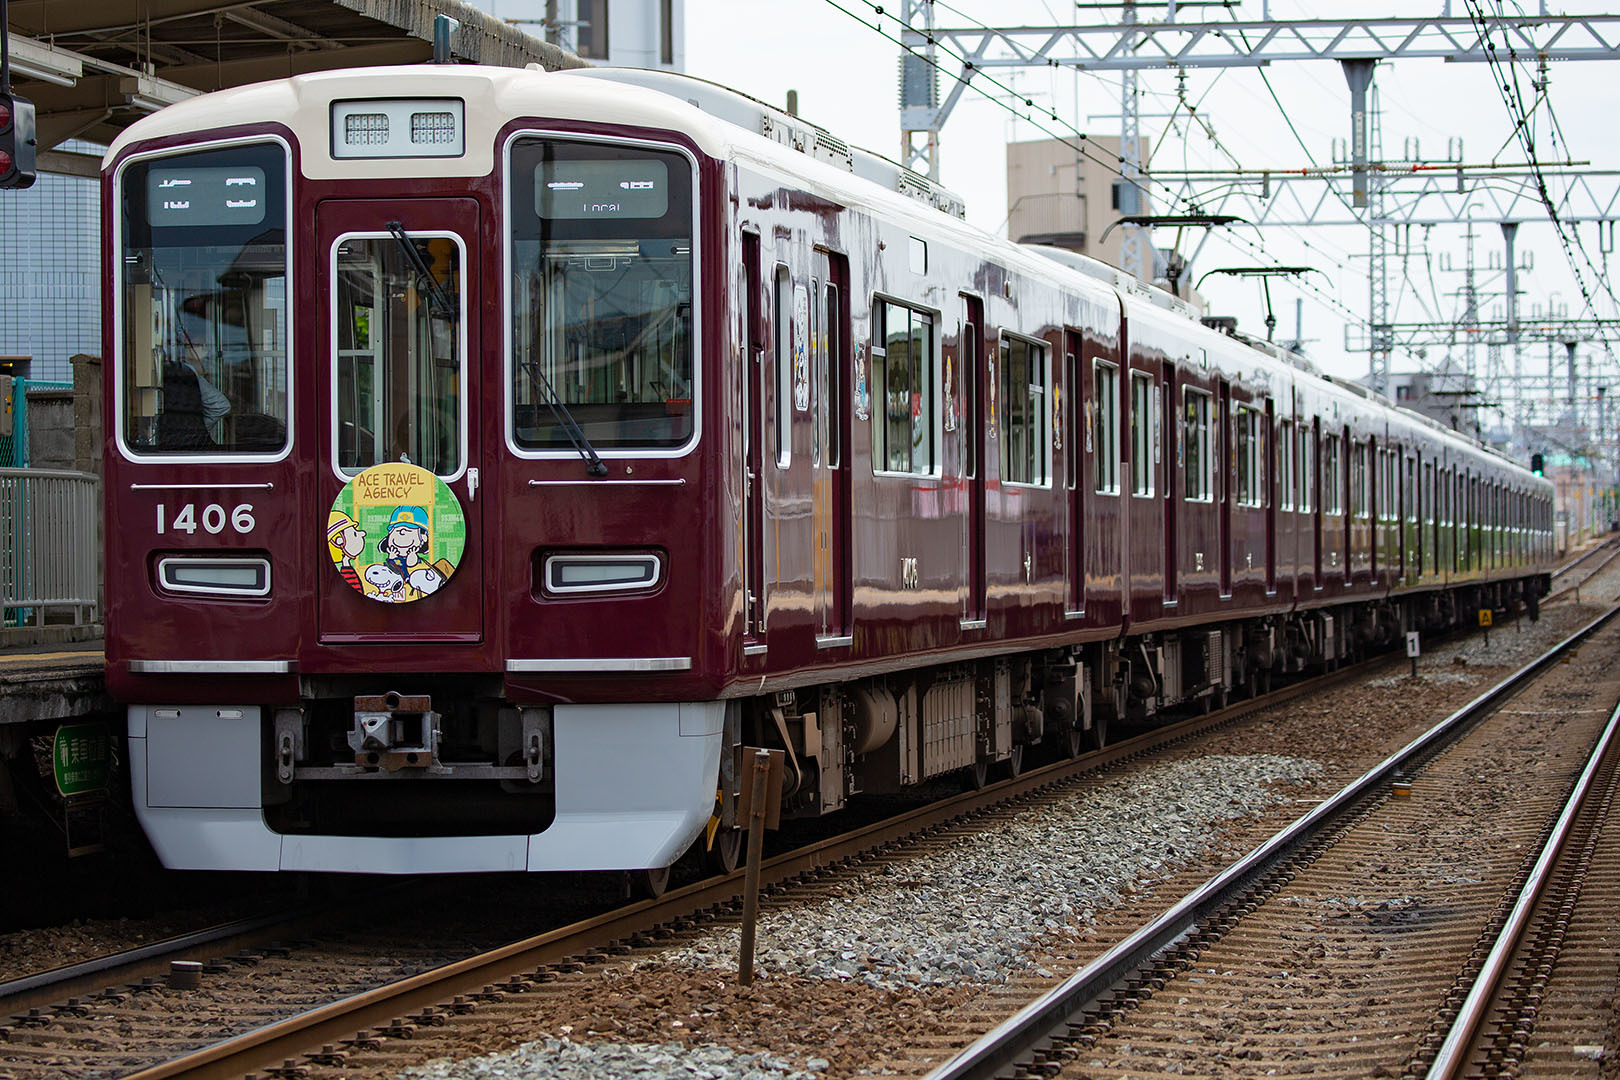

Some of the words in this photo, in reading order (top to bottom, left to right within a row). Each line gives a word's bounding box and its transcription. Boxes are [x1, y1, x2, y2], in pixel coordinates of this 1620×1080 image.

[358, 473, 380, 487] ACE
[383, 471, 425, 486] TRAVEL
[363, 487, 412, 499] AGENCY
[156, 503, 256, 535] 1406
